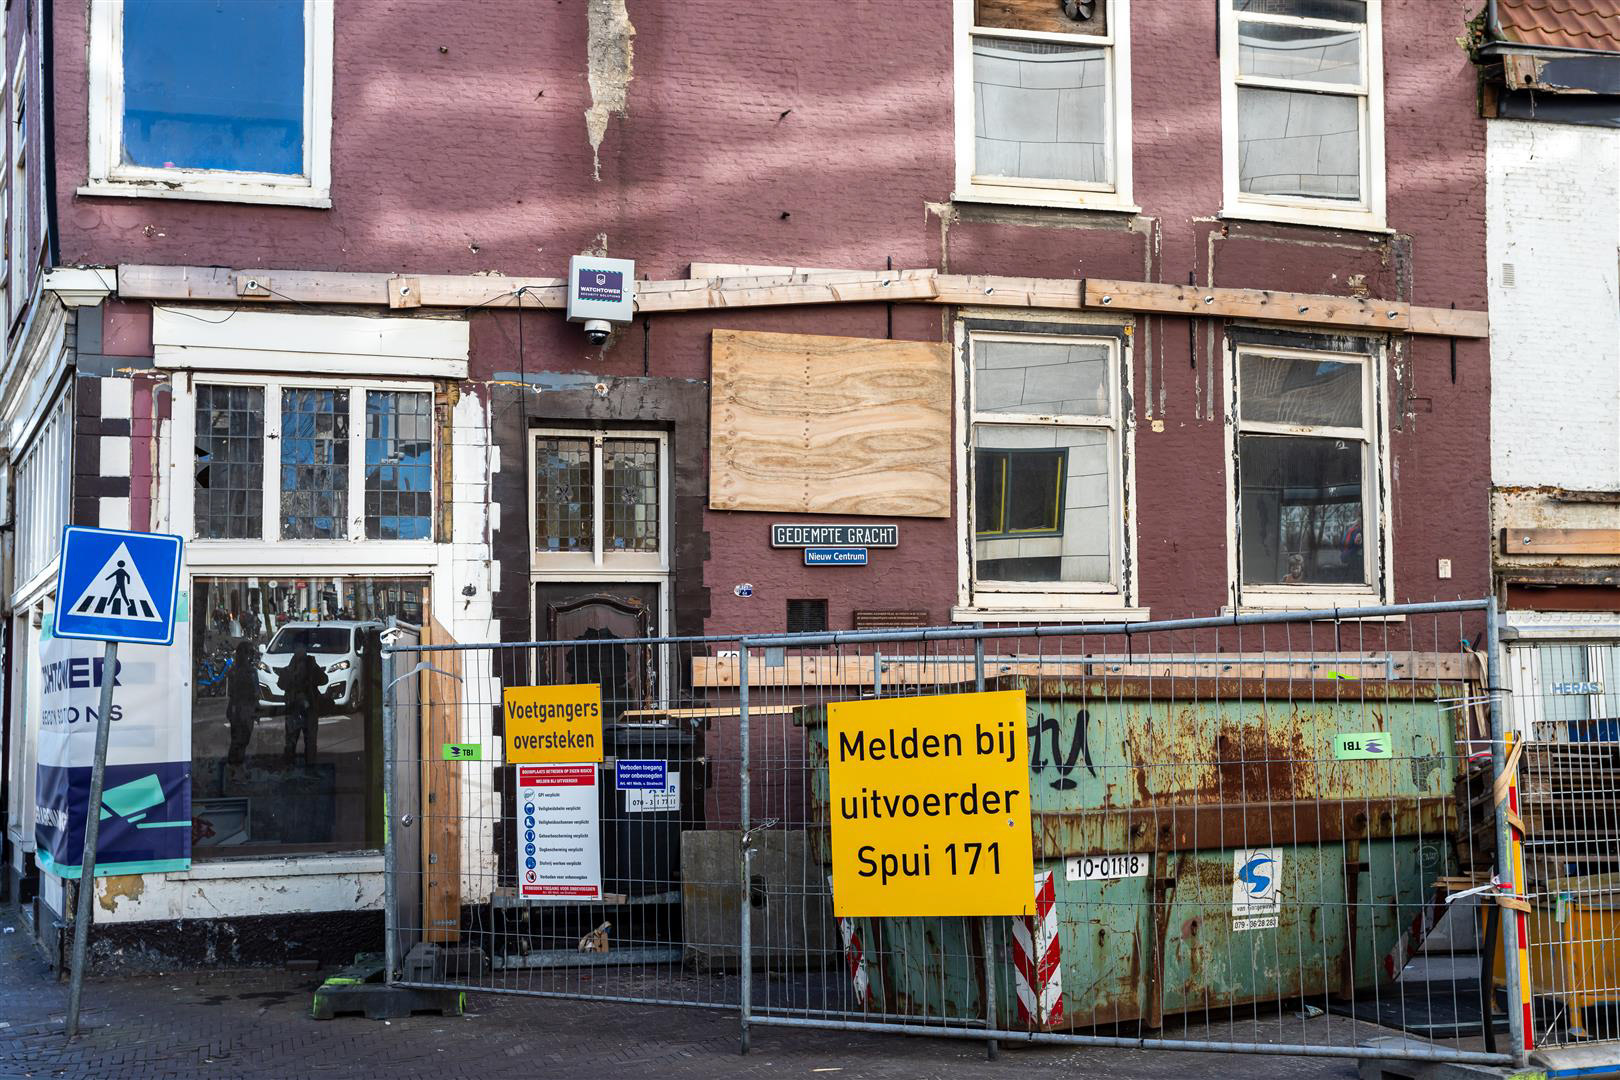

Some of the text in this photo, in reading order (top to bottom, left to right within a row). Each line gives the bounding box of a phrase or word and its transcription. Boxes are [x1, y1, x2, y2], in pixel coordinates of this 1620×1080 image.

[777, 527, 894, 543] GEDEMPTE GRACHT
[808, 552, 865, 560] Nieuw Centrum
[1551, 682, 1599, 694] HERAS
[507, 700, 599, 723] Voetgangers
[513, 730, 595, 750] oversteken
[838, 727, 963, 763] Melden
[975, 721, 1016, 763] bij
[1343, 741, 1362, 751] TBI
[462, 748, 474, 757] TBI
[839, 783, 1020, 820] uitvoerder
[857, 841, 1001, 886] Spui 171
[1076, 856, 1138, 878] 10-01118
